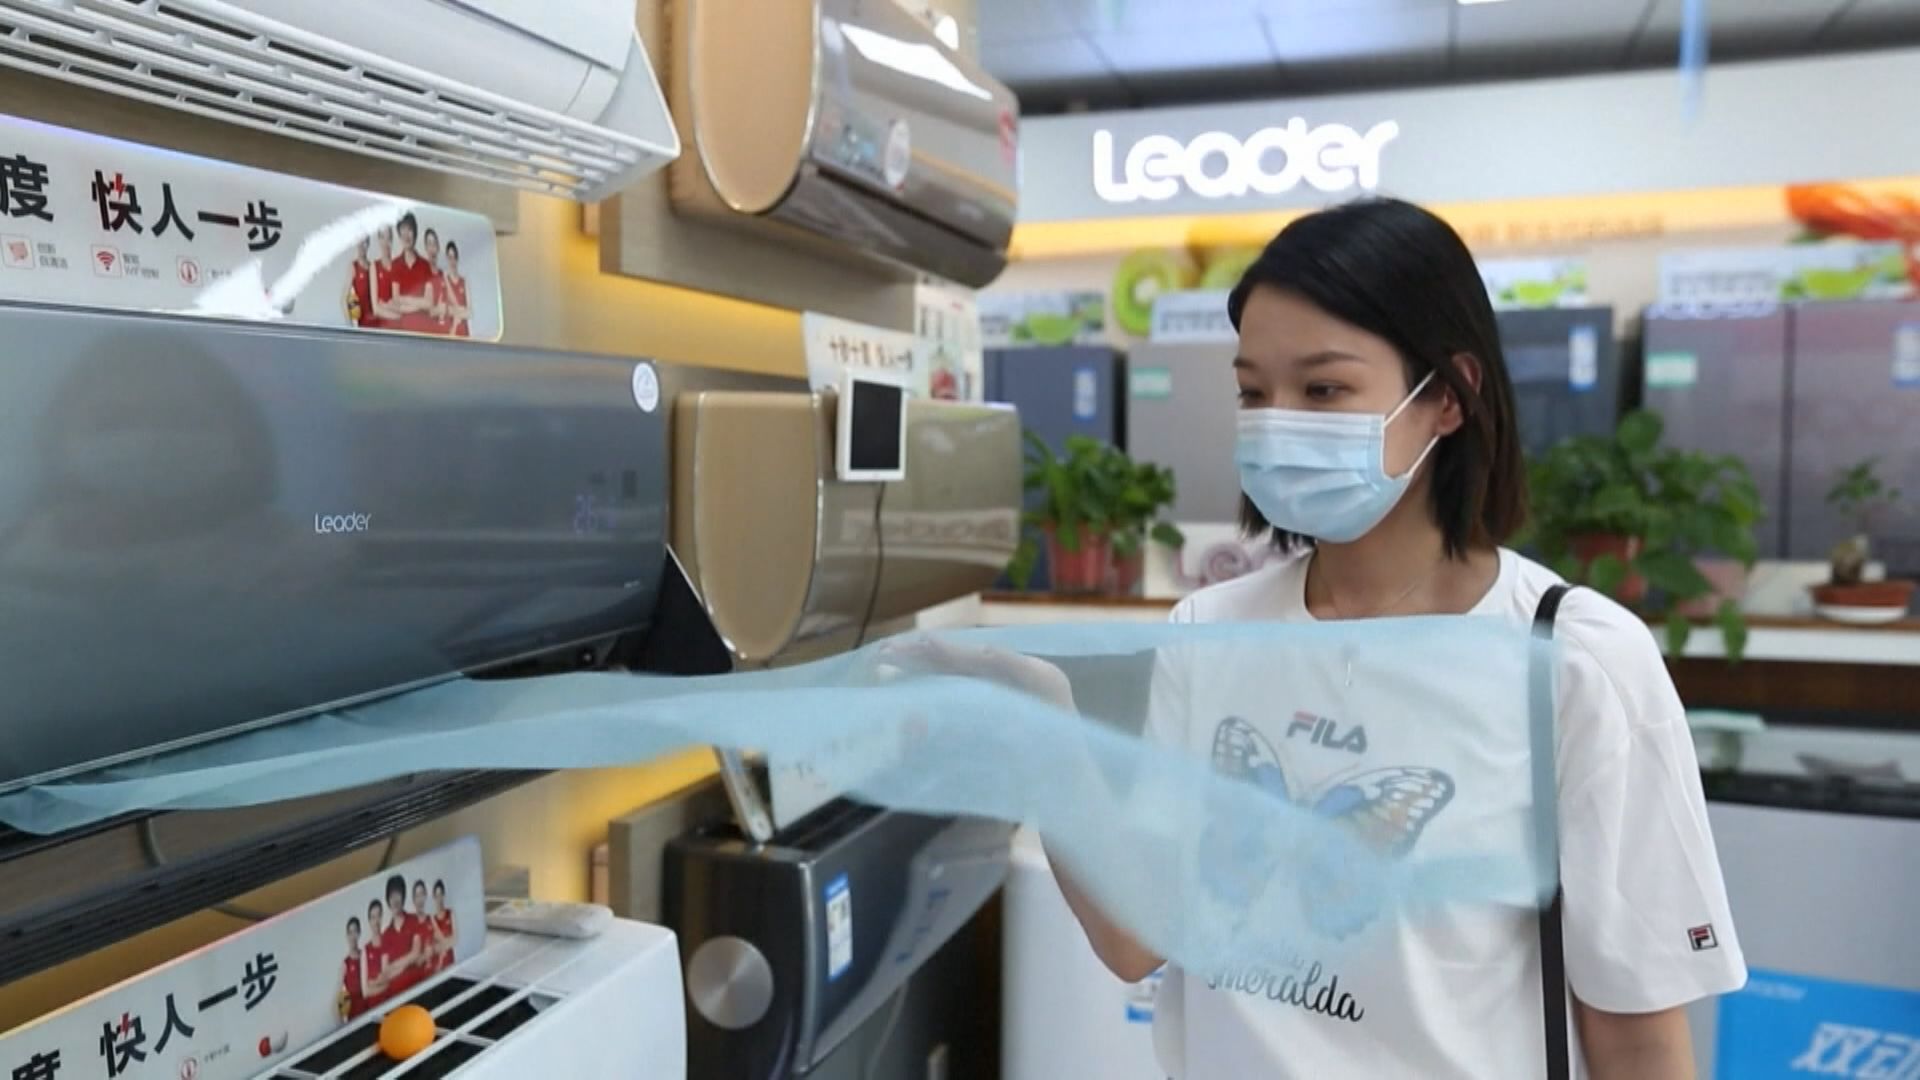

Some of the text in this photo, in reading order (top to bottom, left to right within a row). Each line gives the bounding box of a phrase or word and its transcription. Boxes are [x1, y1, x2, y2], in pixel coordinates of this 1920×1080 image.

[1093, 116, 1399, 202] Leader
[0, 154, 283, 252] 度 快人一步
[314, 511, 372, 534] Leader
[1285, 708, 1368, 754] FILA
[99, 952, 279, 1078] 快人一步
